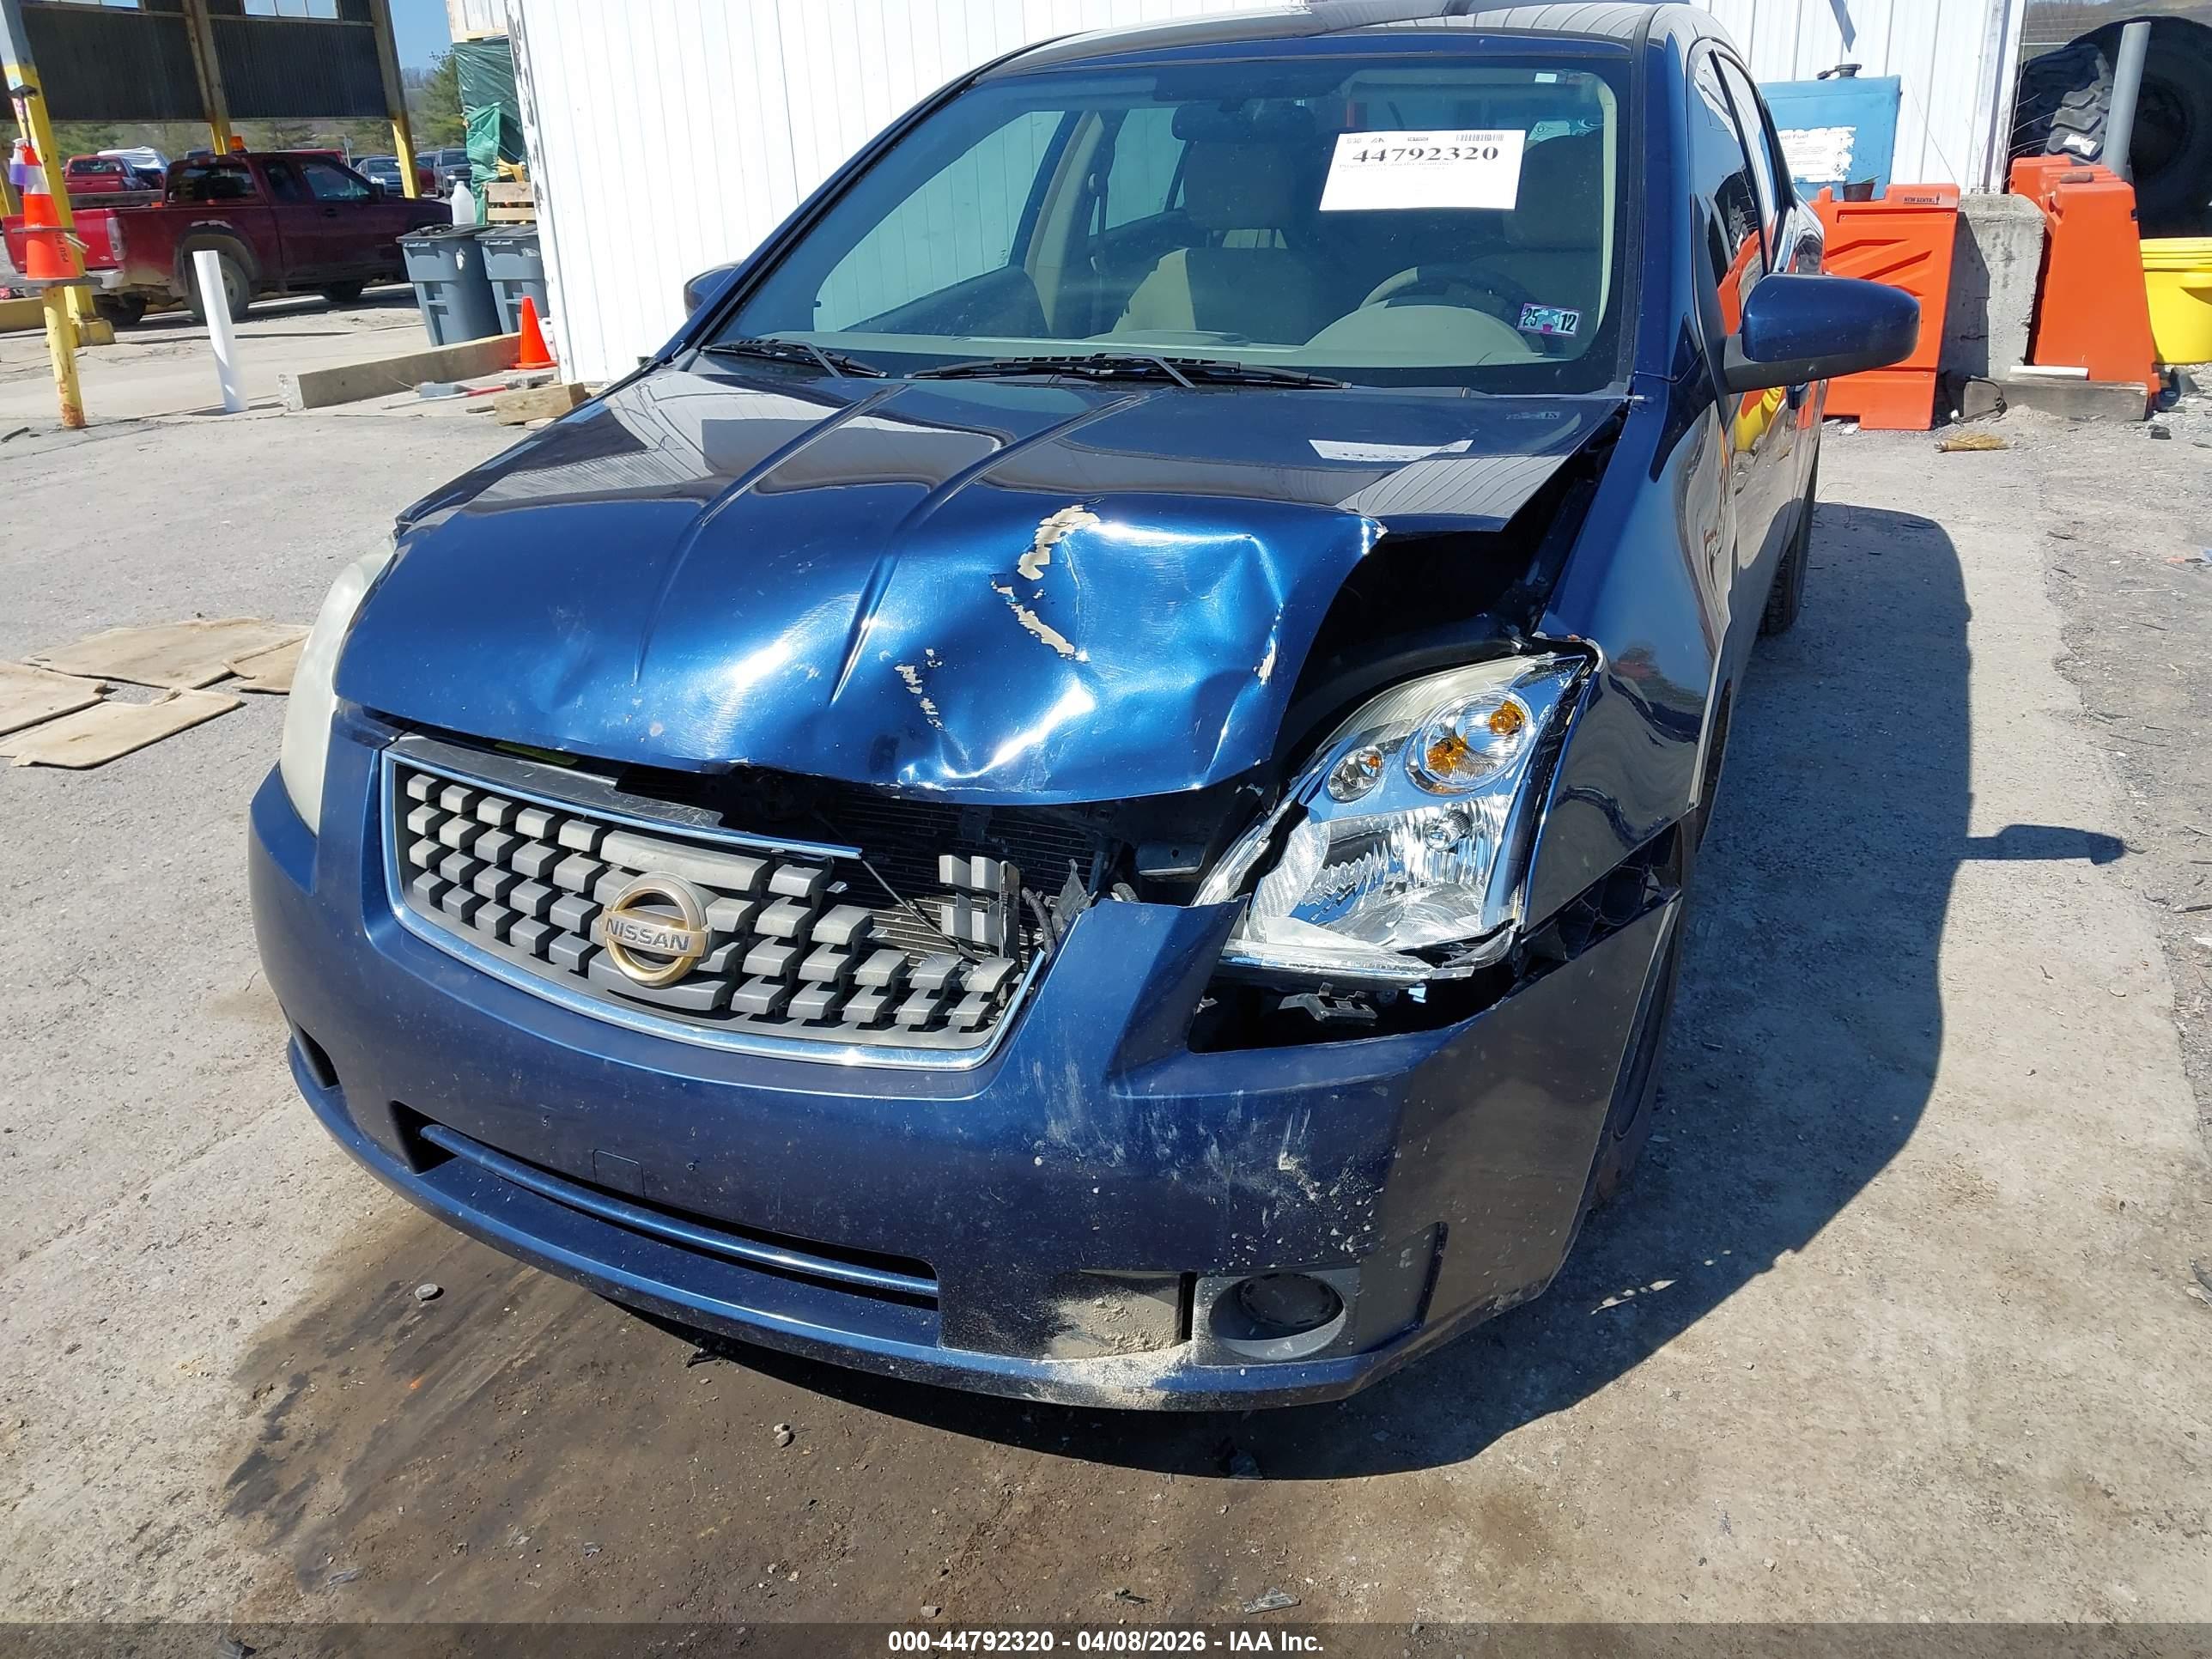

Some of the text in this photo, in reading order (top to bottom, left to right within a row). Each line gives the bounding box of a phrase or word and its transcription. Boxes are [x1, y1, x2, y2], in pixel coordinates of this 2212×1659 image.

[1352, 147, 1499, 162] 44792320
[1523, 307, 1577, 332] 25 12
[605, 917, 690, 951] NISSAN
